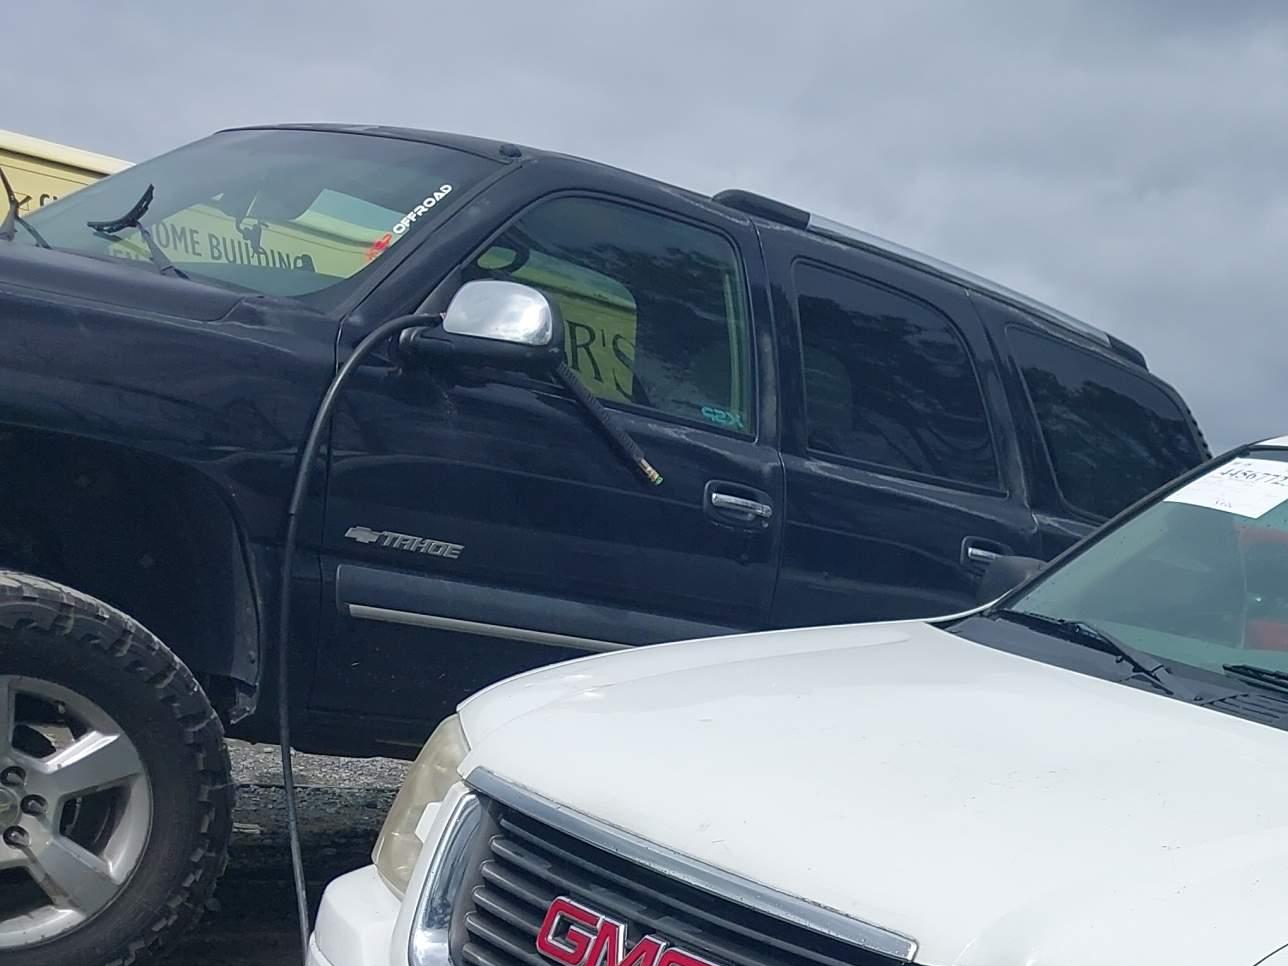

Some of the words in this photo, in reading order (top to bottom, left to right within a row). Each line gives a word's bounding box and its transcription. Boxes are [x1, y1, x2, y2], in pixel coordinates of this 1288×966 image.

[393, 184, 452, 233] OFFROAD
[155, 223, 202, 257] OME
[564, 320, 635, 401] R'S
[383, 531, 464, 559] TAHOE
